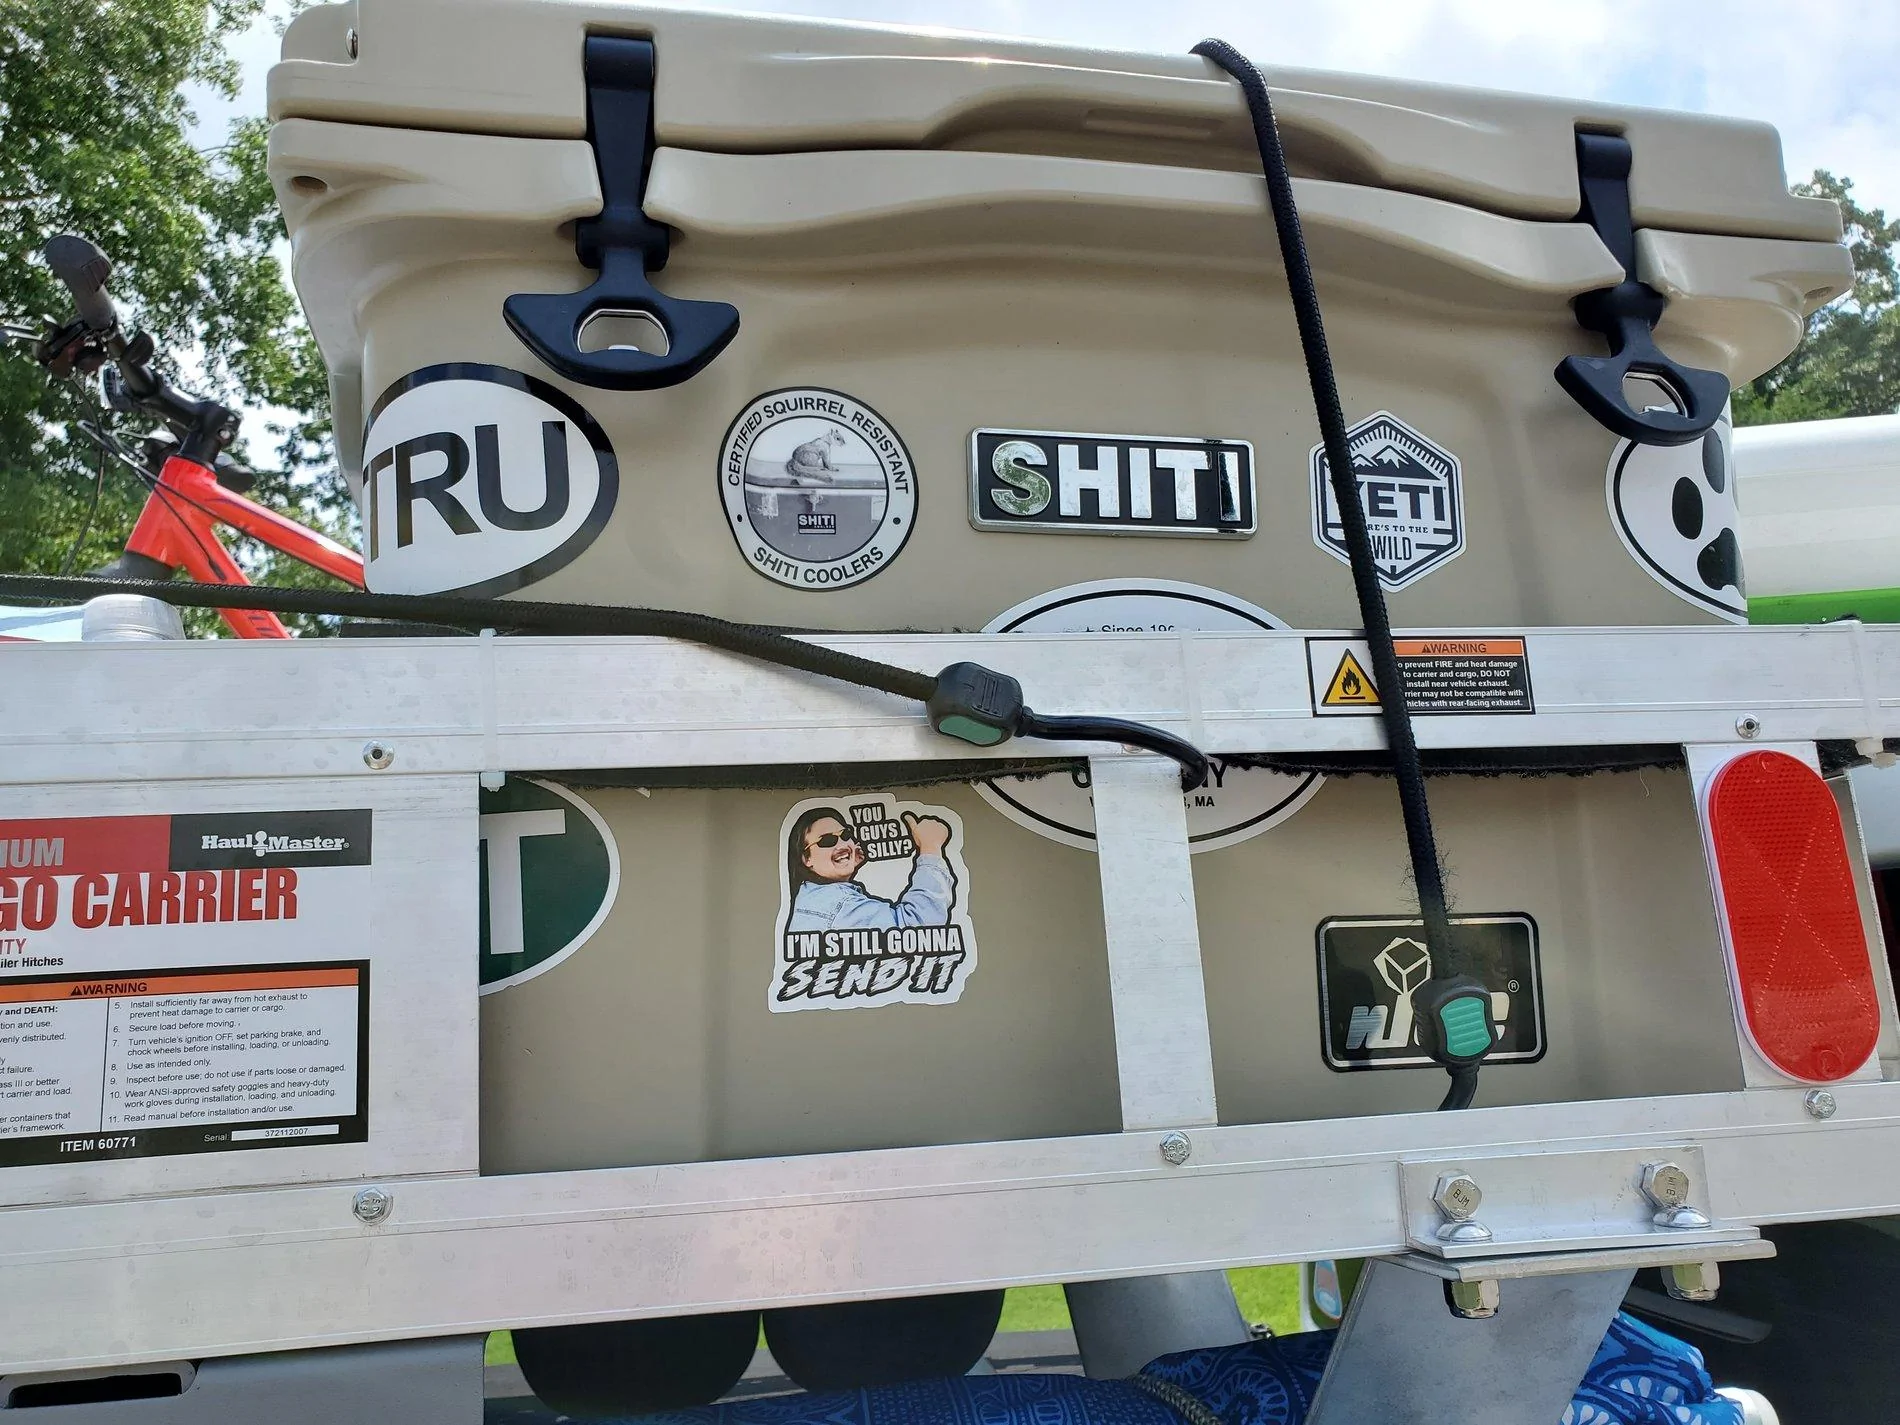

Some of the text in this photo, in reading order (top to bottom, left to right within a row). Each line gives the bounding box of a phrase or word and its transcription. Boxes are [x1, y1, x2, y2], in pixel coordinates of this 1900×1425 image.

[728, 397, 908, 494] CERTIFIED SQUIRREL RESISTANT
[991, 440, 1242, 522] SHITI
[363, 420, 570, 563] TRU
[1329, 480, 1446, 521] ETI
[799, 515, 834, 525] SHITI
[1372, 535, 1412, 560] WILD
[754, 546, 883, 583] SHITI COOLERS
[1430, 643, 1486, 653] WARNING
[1489, 661, 1517, 669] damage
[1465, 690, 1506, 698] compatible
[1449, 700, 1490, 708] rear-facing
[1195, 796, 1215, 806] MA
[853, 806, 882, 822] YOU
[860, 824, 897, 840] GUYS
[201, 834, 345, 850] Haul Master
[867, 838, 912, 859] SILLY?
[72, 868, 298, 929] CARRIER
[787, 928, 961, 958] I'M STILL GONNA
[22, 957, 63, 967] Hitches
[781, 953, 961, 998] SEND IT
[82, 982, 147, 995] WARNING
[156, 999, 197, 1007] sufficiently
[234, 995, 251, 1003] from
[24, 1006, 58, 1014] DEATH:
[129, 1010, 160, 1019] prevent
[181, 1008, 213, 1016] damage
[129, 1024, 157, 1032] Secure
[206, 1020, 236, 1028] moving.
[22, 1033, 66, 1042] distributed.
[185, 1035, 213, 1043] ignition
[215, 1033, 233, 1041] OFF,
[250, 1031, 278, 1040] parking
[128, 1048, 151, 1056] chock
[154, 1046, 181, 1054] wheels
[184, 1045, 208, 1053] before
[210, 1043, 247, 1051] installing,
[7, 1066, 34, 1074] failure.
[126, 1062, 143, 1070] Use
[157, 1060, 191, 1068] intended
[194, 1059, 211, 1067] only.
[126, 1076, 155, 1084] Inspect
[254, 1068, 273, 1077] parts
[6, 1090, 33, 1098] carrier
[125, 1090, 147, 1098] Wear
[148, 1086, 209, 1096] ANSI-approved
[237, 1082, 268, 1091] goggles
[270, 1081, 285, 1089] and
[287, 1079, 329, 1087] heavy-duty
[124, 1100, 144, 1108] work
[146, 1099, 172, 1108] gloves
[174, 1097, 199, 1105] during
[201, 1095, 246, 1103] installation,
[248, 1092, 278, 1100] loading,
[10, 1114, 53, 1122] containers
[148, 1112, 178, 1120] manual
[180, 1110, 205, 1118] before
[207, 1108, 249, 1116] installation
[251, 1106, 276, 1114] and/or
[20, 1124, 65, 1132] framework.
[204, 1128, 308, 1142] Serial: 372112007
[60, 1136, 136, 1153] ITEM 60771
